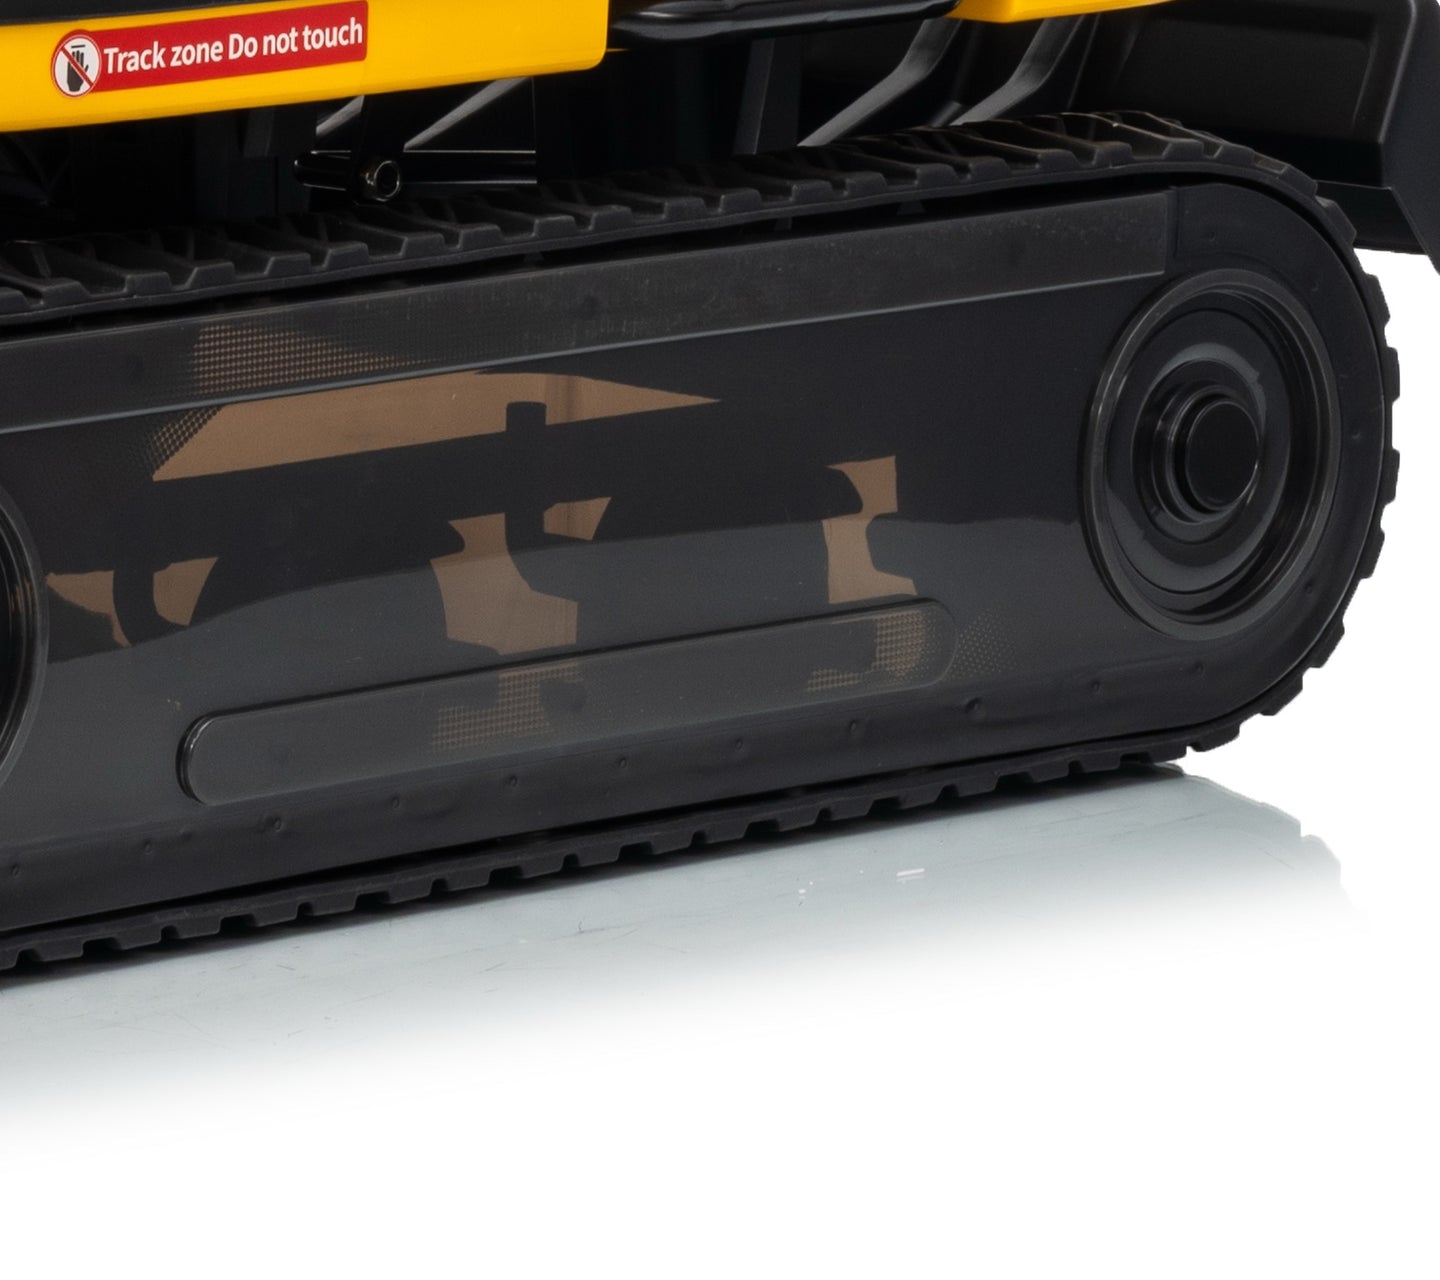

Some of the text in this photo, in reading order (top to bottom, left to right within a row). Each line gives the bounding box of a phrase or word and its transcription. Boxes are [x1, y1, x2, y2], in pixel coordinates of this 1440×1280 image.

[104, 17, 363, 74] Track zone Do not touch
